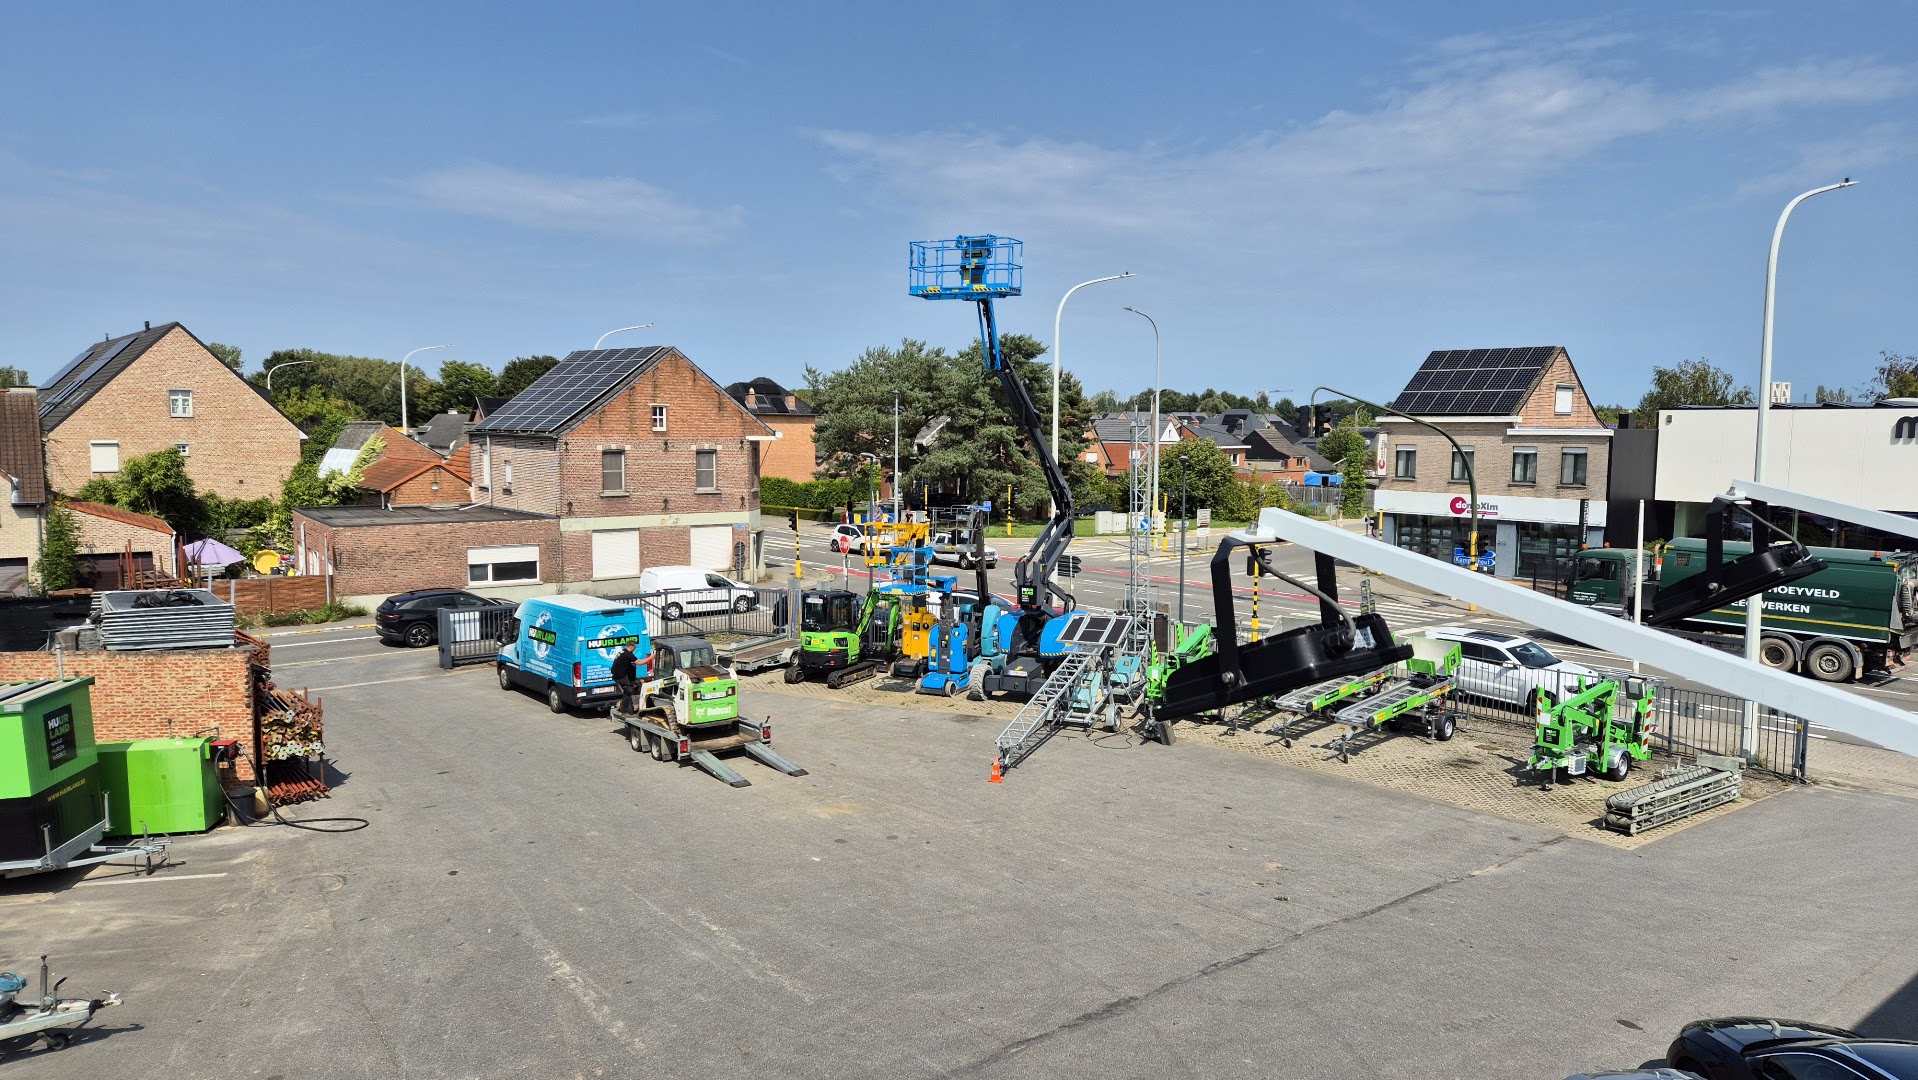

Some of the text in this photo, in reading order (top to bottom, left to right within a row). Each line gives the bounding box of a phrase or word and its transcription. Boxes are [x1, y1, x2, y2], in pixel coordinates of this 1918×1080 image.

[1455, 557, 1490, 567] Kamphout
[47, 713, 69, 730] HUUR
[49, 723, 70, 739] LAND
